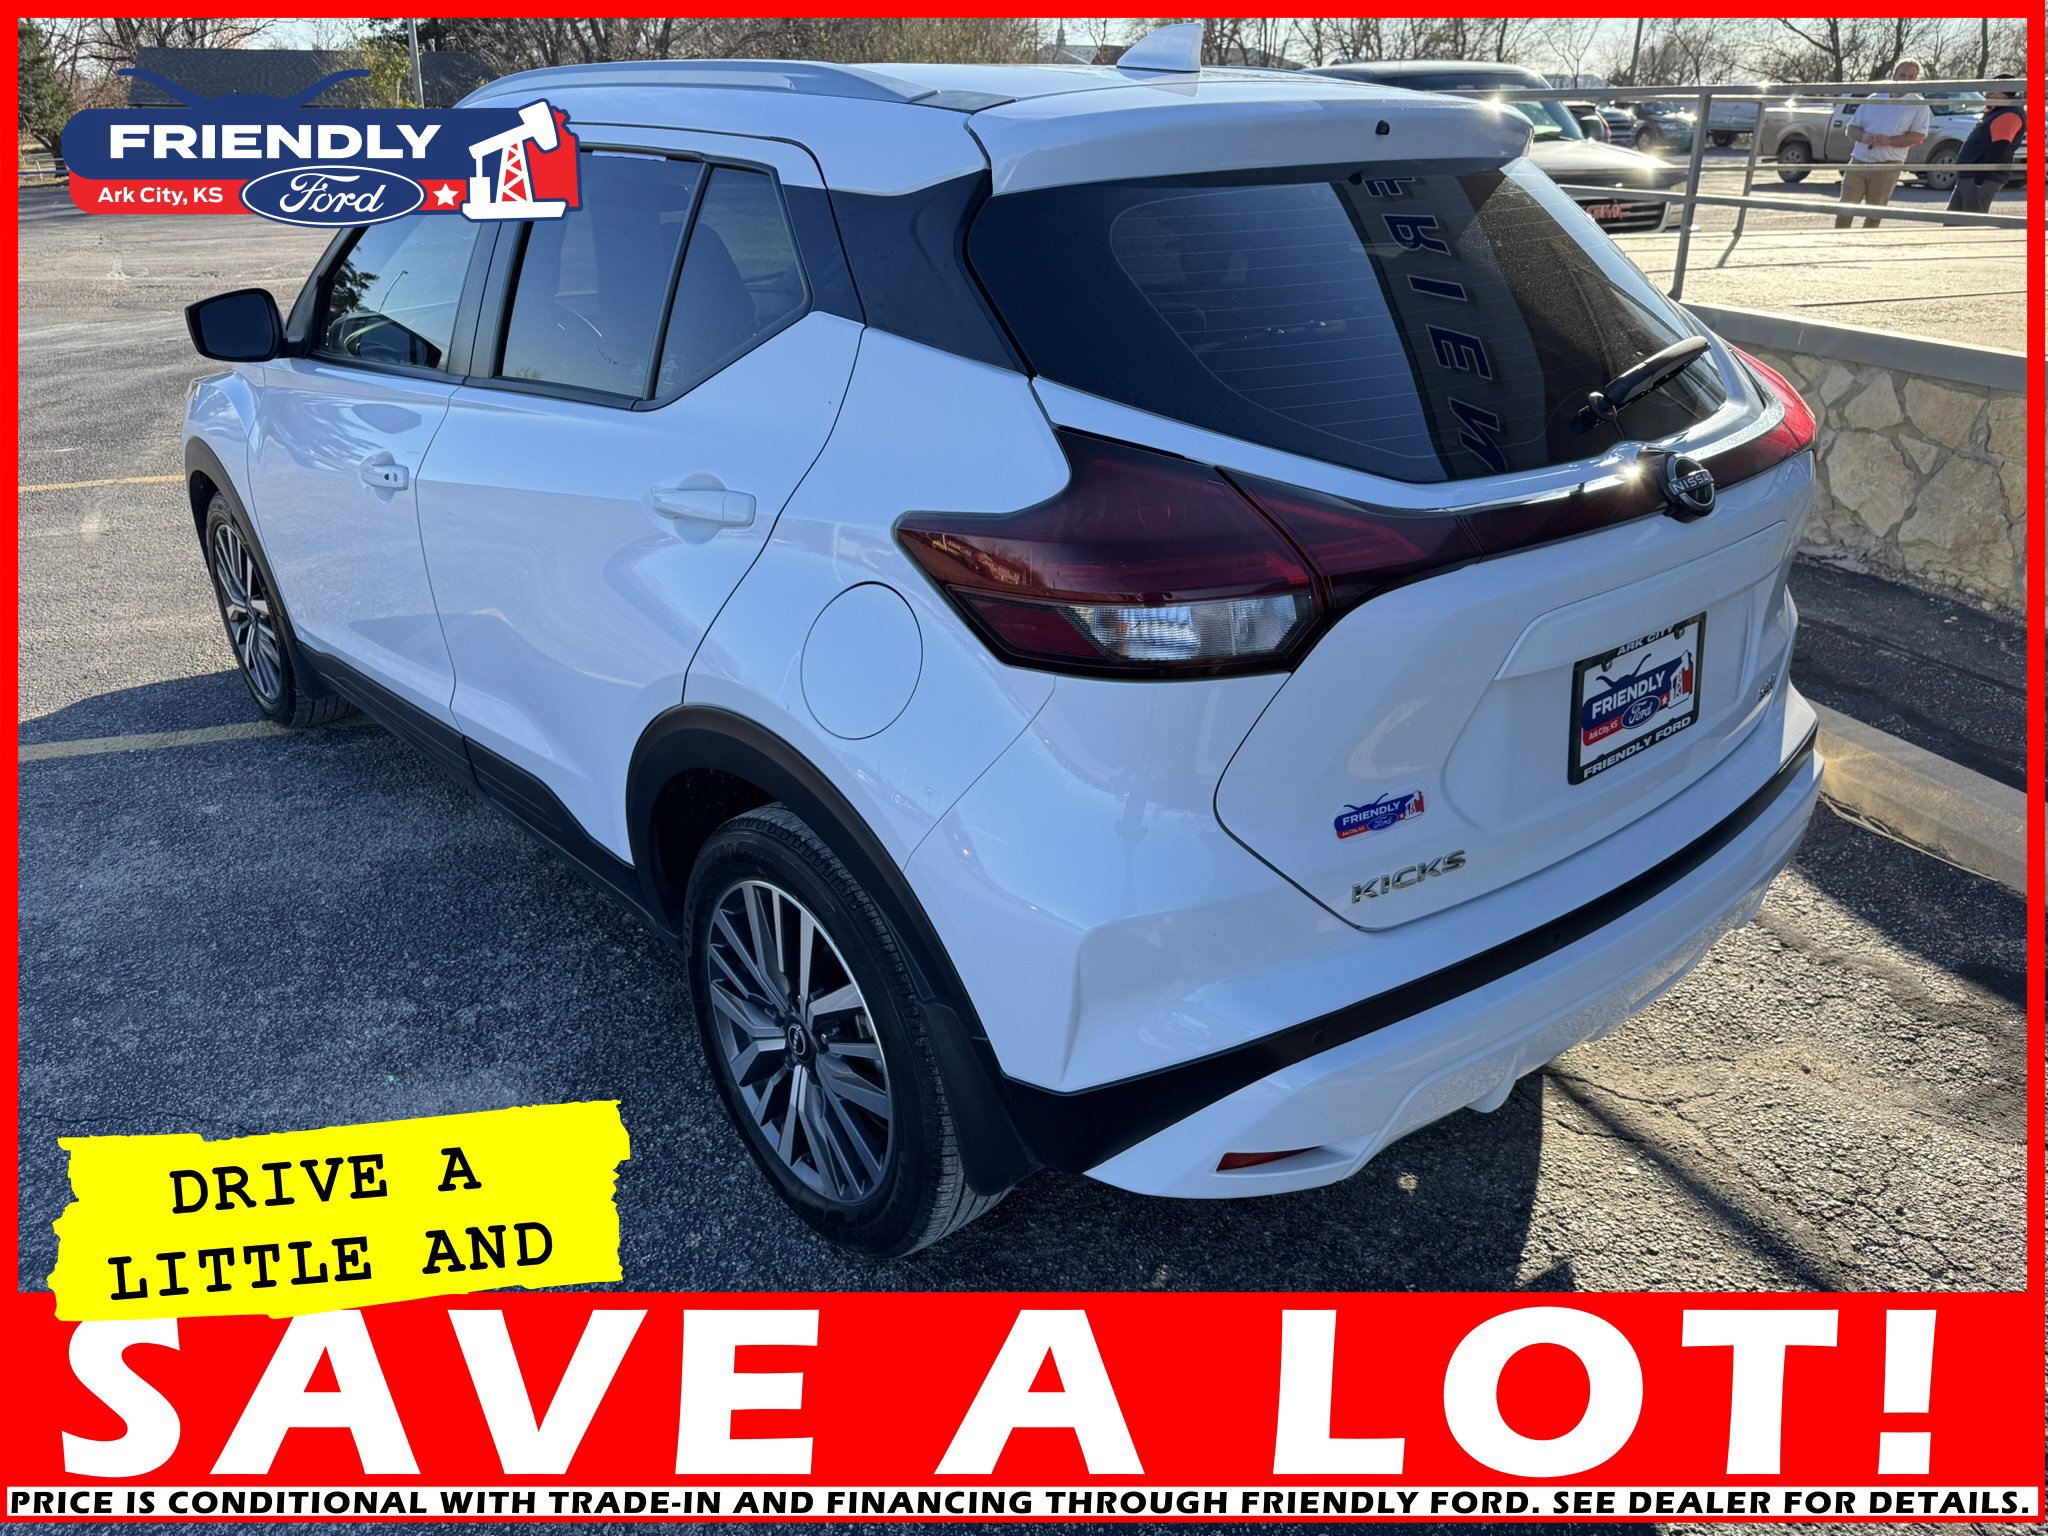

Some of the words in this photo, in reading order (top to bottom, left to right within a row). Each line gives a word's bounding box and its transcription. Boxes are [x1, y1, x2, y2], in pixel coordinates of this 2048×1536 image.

[1586, 203, 1632, 219] GMC
[1617, 637, 1644, 656] ARK
[1646, 624, 1674, 643] CITY
[1591, 670, 1666, 720] FRIENDLY
[1629, 698, 1653, 725] Ford
[1583, 736, 1652, 780] FRIENDLY
[1655, 716, 1692, 743] FORD
[1342, 801, 1400, 827] FRIENDLY
[1351, 849, 1466, 905] KICKS
